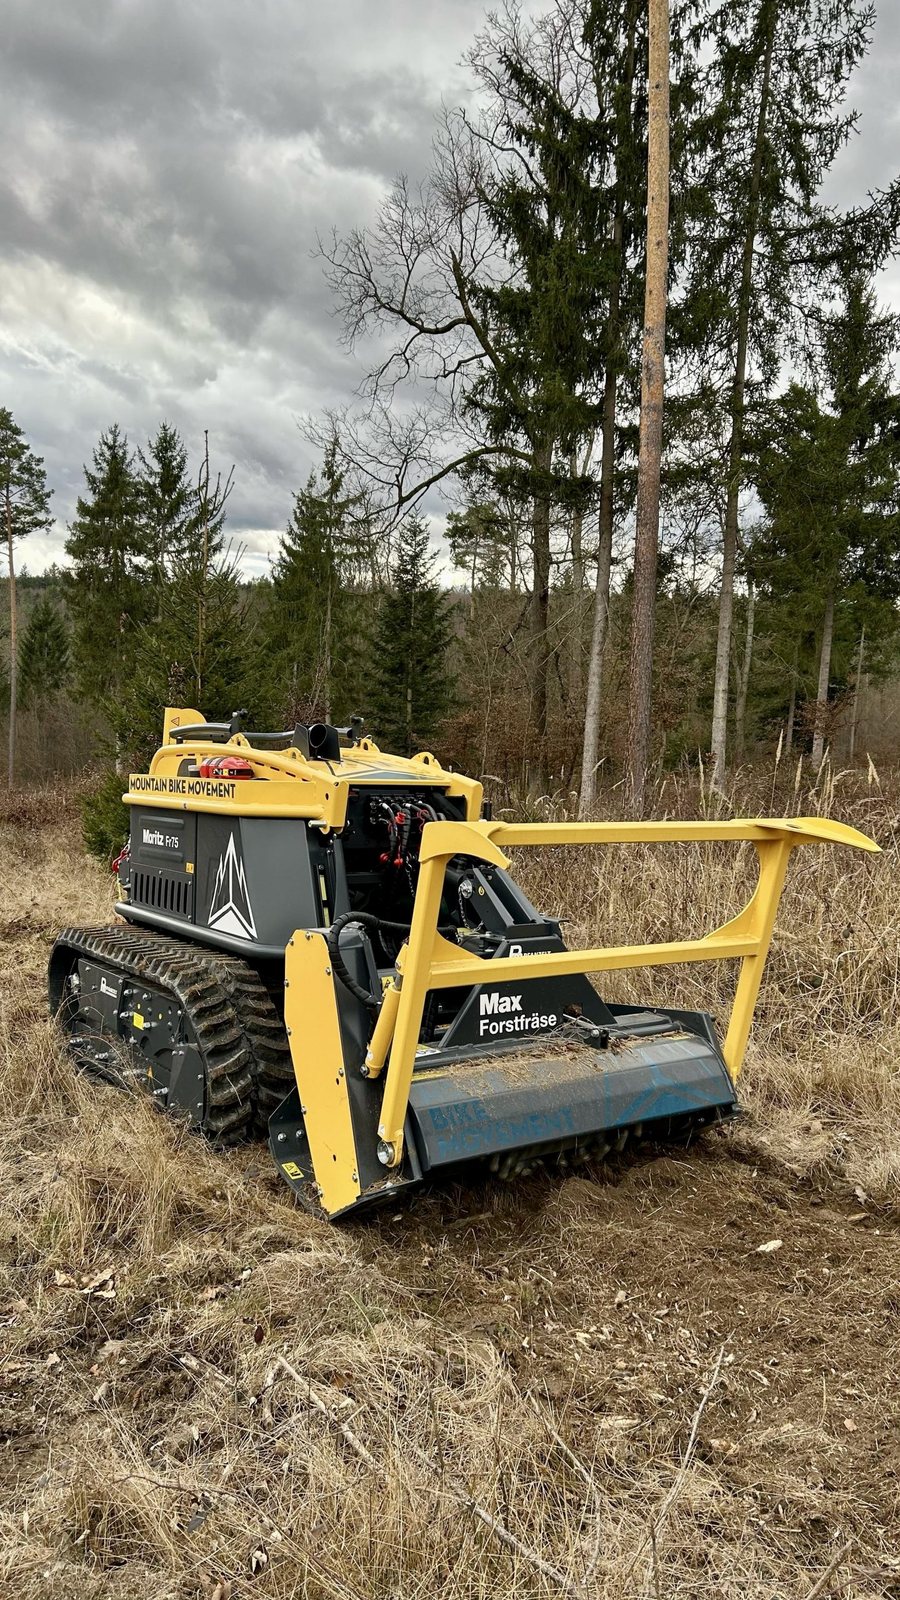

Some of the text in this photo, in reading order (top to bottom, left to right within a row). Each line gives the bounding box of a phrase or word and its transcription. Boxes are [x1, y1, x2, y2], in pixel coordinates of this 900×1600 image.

[130, 777, 236, 798] MOUNTAIN BIKE MOVEMENT
[142, 828, 179, 849] Moritz Fr75
[479, 992, 523, 1016] Max
[479, 1012, 557, 1036] Forstfräse
[428, 1099, 490, 1130] BIKE
[437, 1104, 575, 1160] MOVEMENT
